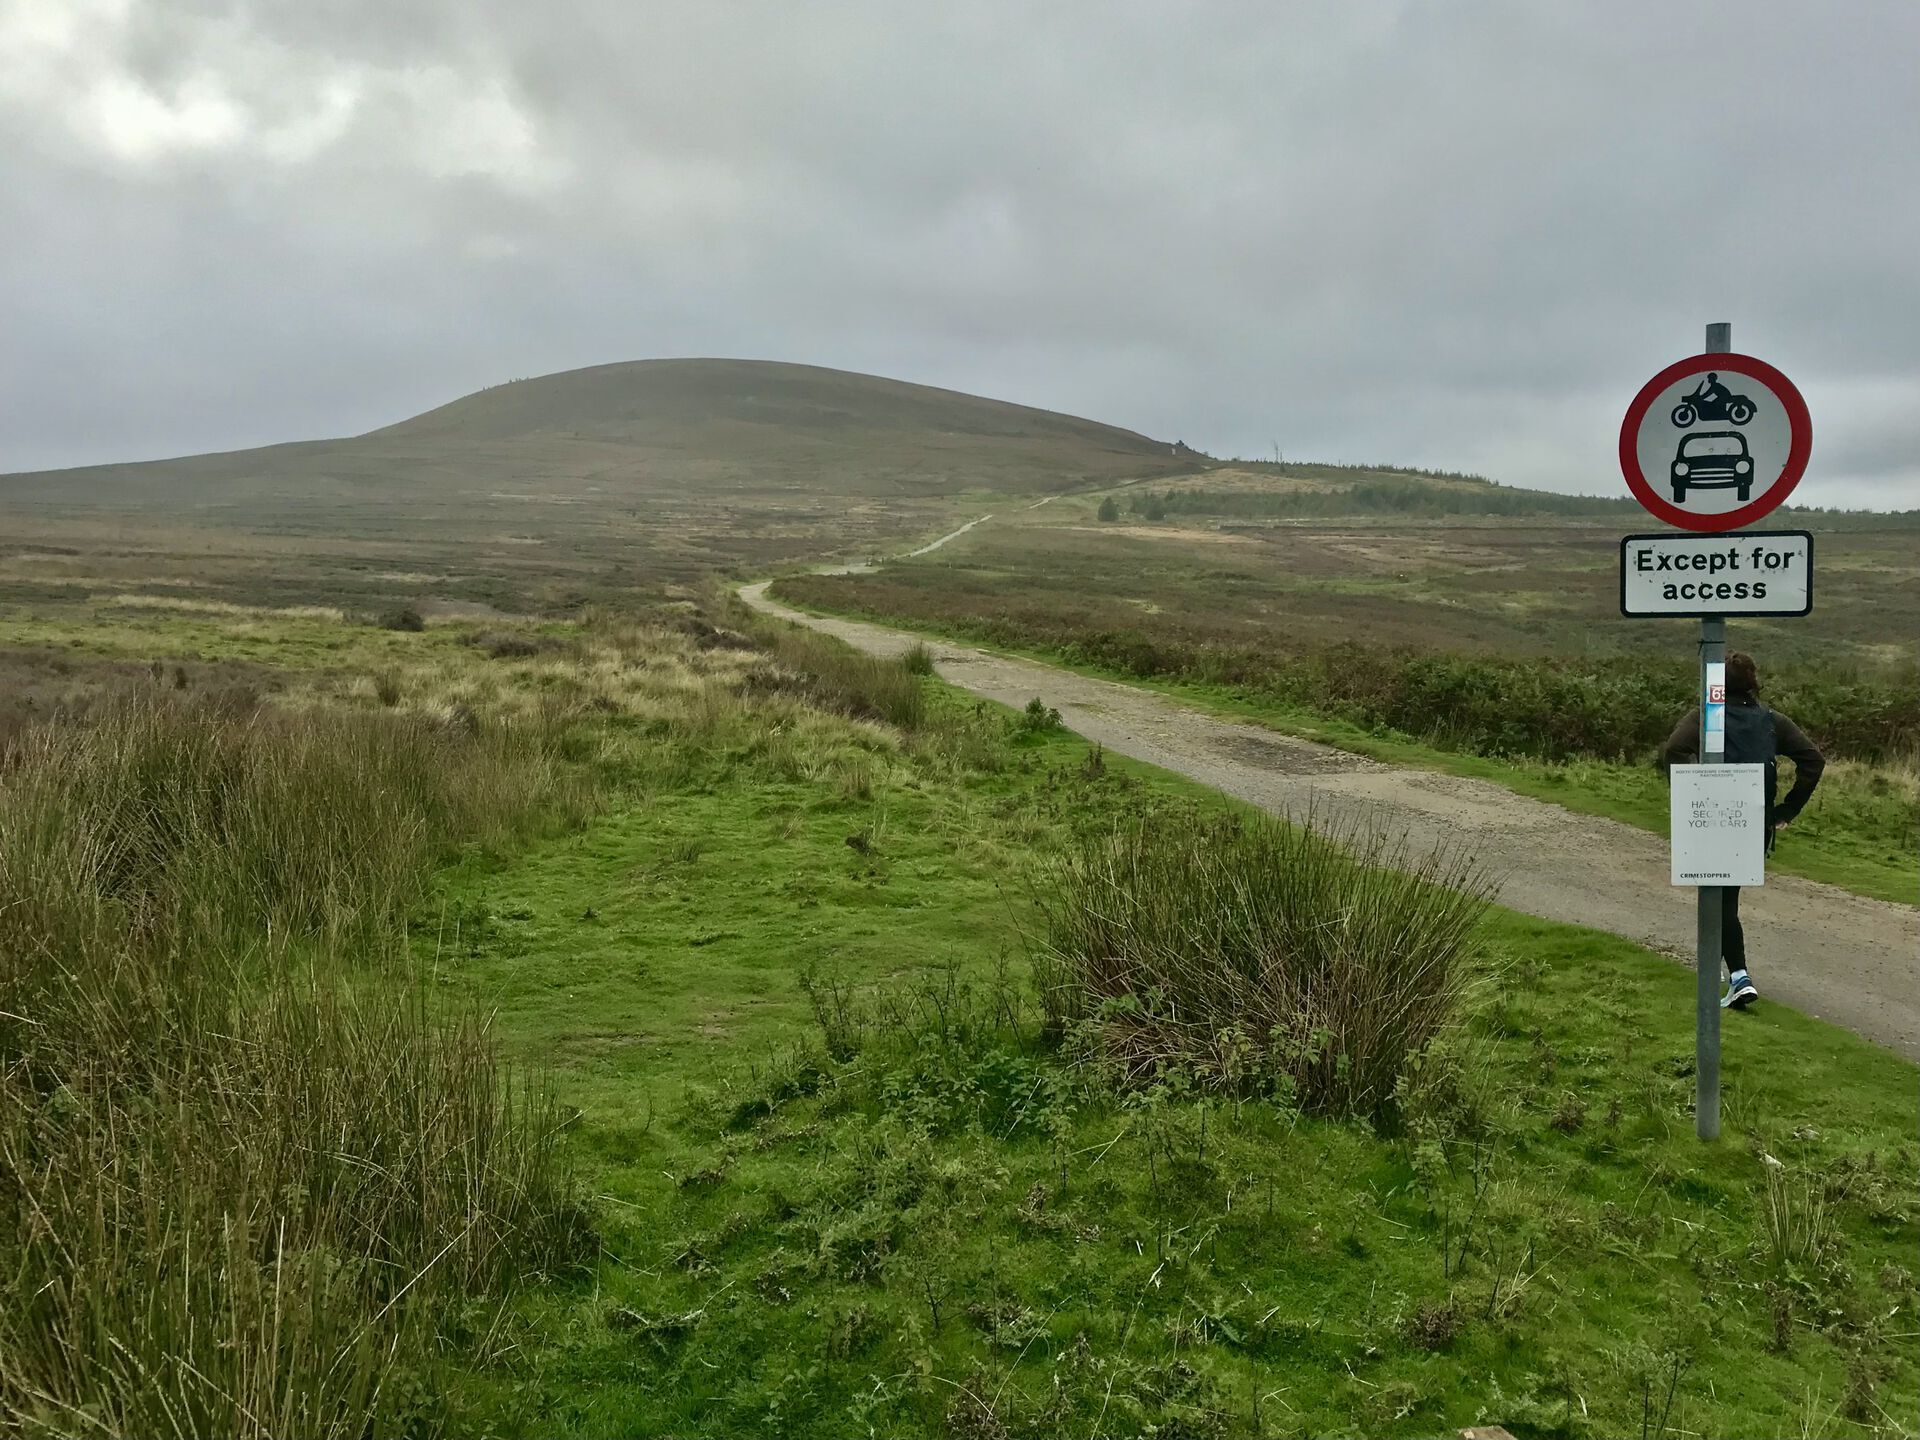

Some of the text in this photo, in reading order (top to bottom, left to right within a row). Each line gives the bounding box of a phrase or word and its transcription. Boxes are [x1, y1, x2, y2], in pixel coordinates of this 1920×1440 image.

[1637, 547, 1795, 574] Except for
[1663, 582, 1767, 600] access
[1688, 819, 1748, 828] YOU CAR?
